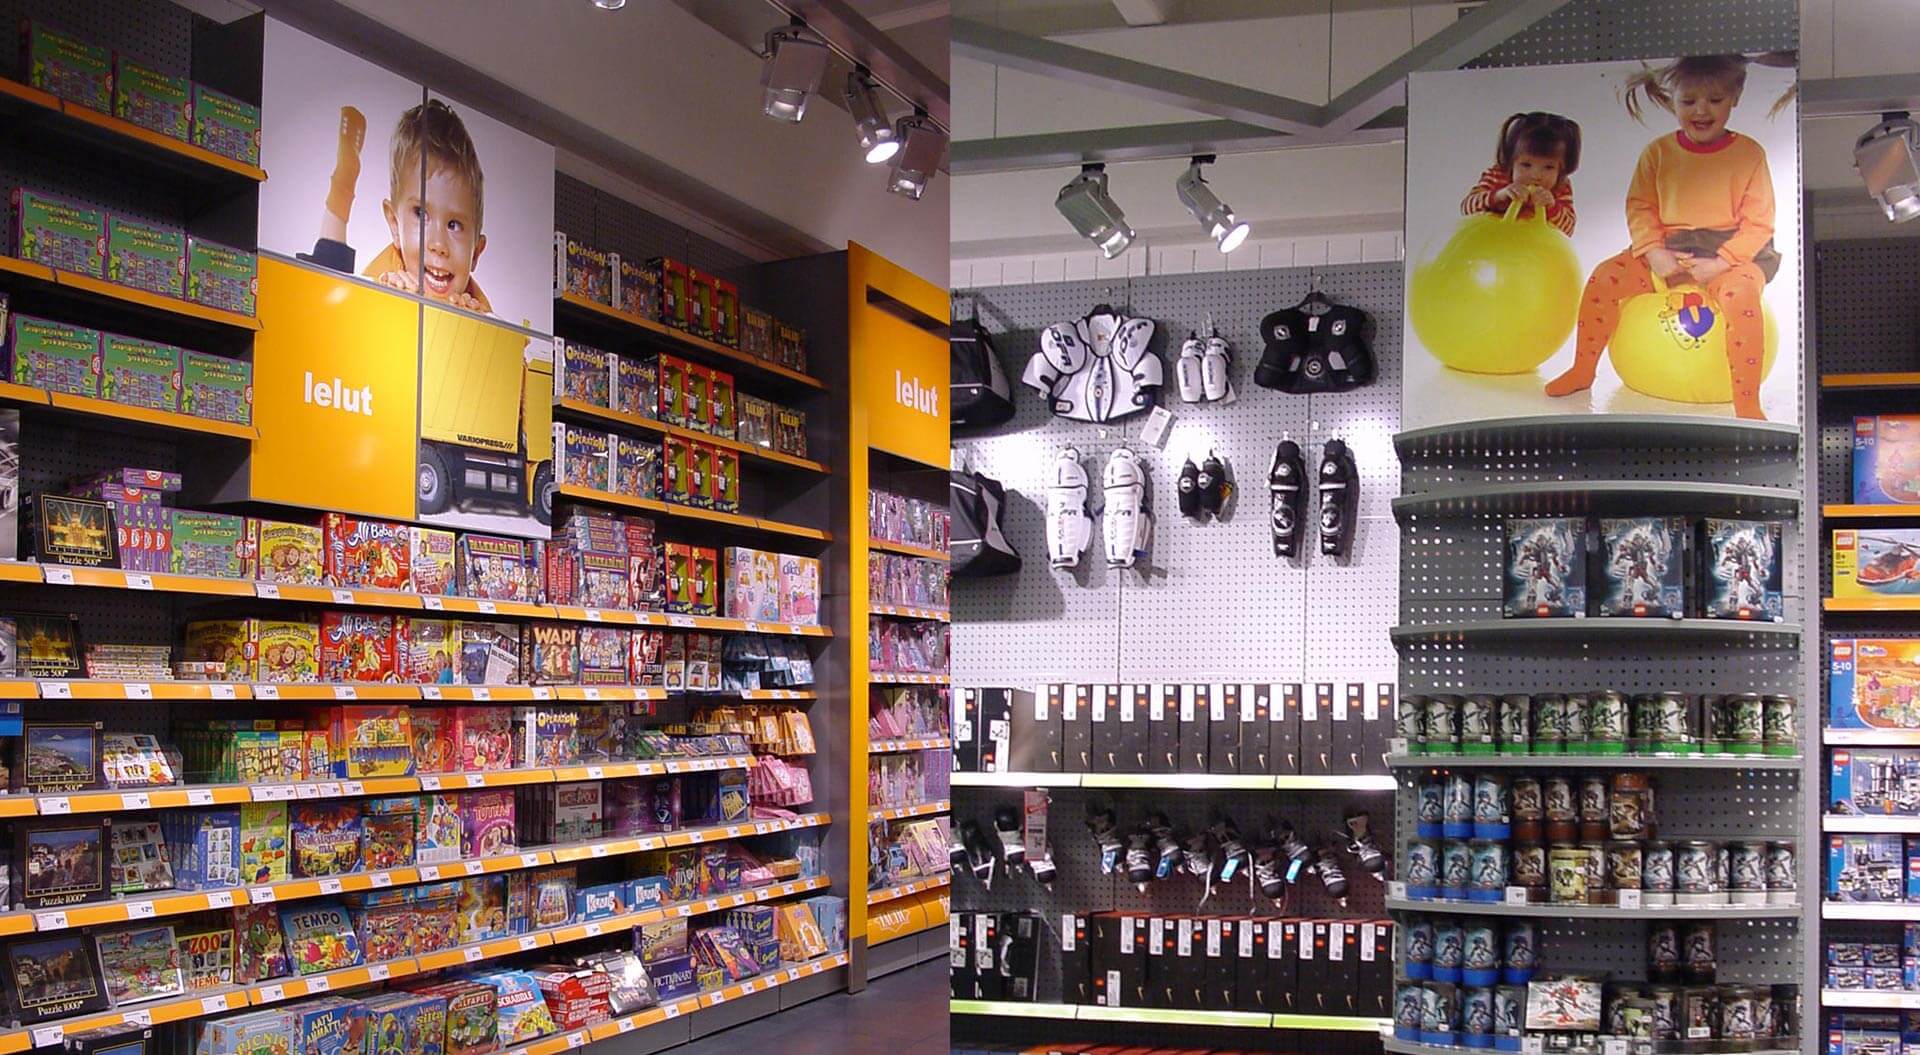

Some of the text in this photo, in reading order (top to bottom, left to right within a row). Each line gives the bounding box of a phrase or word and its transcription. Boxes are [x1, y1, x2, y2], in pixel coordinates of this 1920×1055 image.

[304, 372, 373, 416] lelut
[895, 369, 938, 417] lelut
[59, 555, 82, 565] Puzzle
[38, 784, 62, 793] Puzzle
[39, 897, 64, 907] Puzzle
[293, 912, 341, 930] TEMPO
[191, 934, 220, 954] ZOO
[188, 975, 220, 989] MEMO
[37, 1005, 62, 1016] Puzzle
